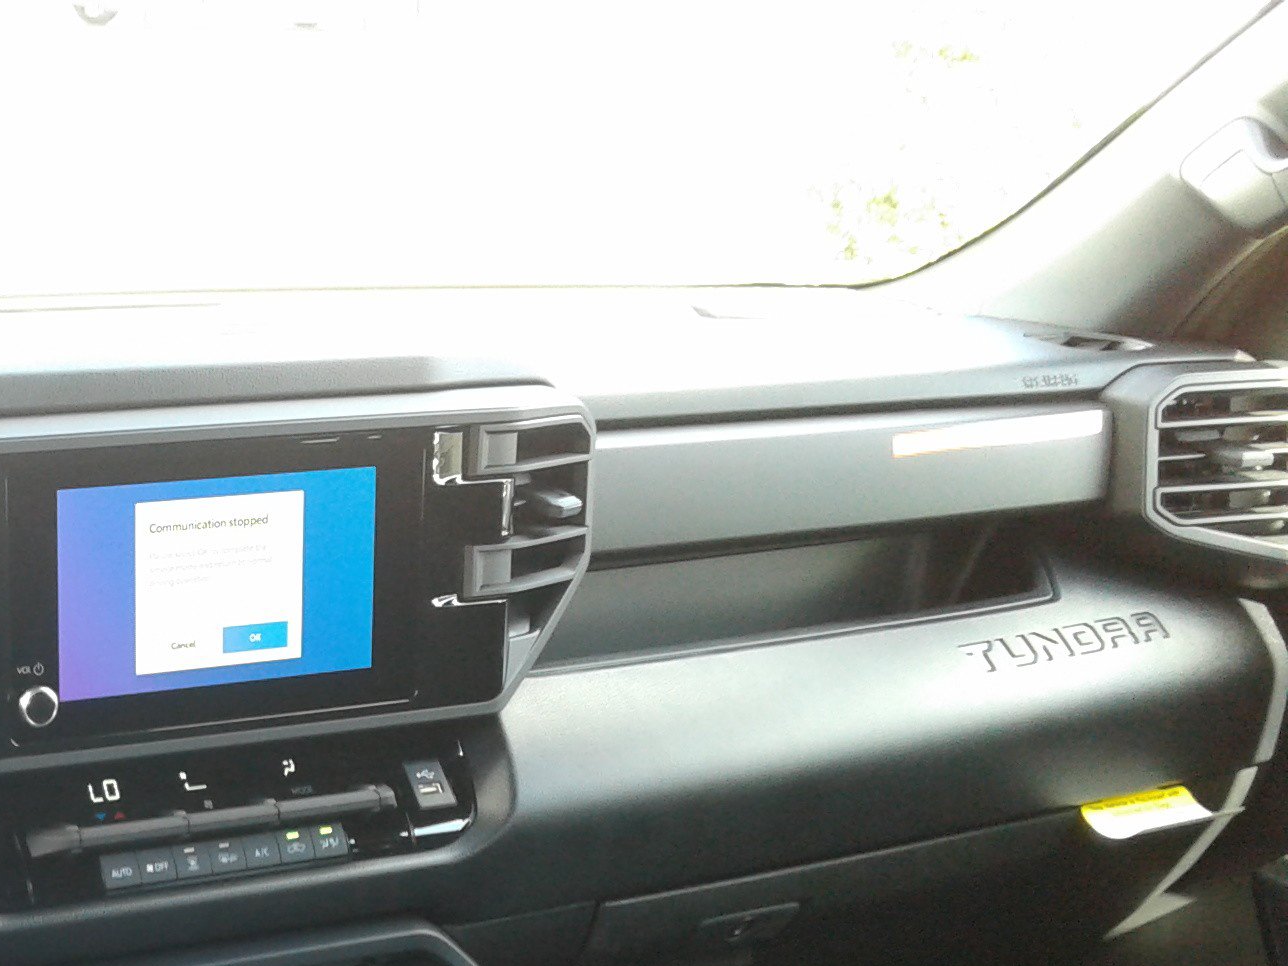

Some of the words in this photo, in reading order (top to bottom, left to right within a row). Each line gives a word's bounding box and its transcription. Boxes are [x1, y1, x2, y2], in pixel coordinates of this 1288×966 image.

[149, 519, 226, 534] Communication
[229, 514, 269, 528] stopped
[171, 640, 196, 650] Cancel
[957, 611, 1171, 673] TUNDRA
[87, 778, 121, 803] LO
[111, 867, 133, 878] AUTO
